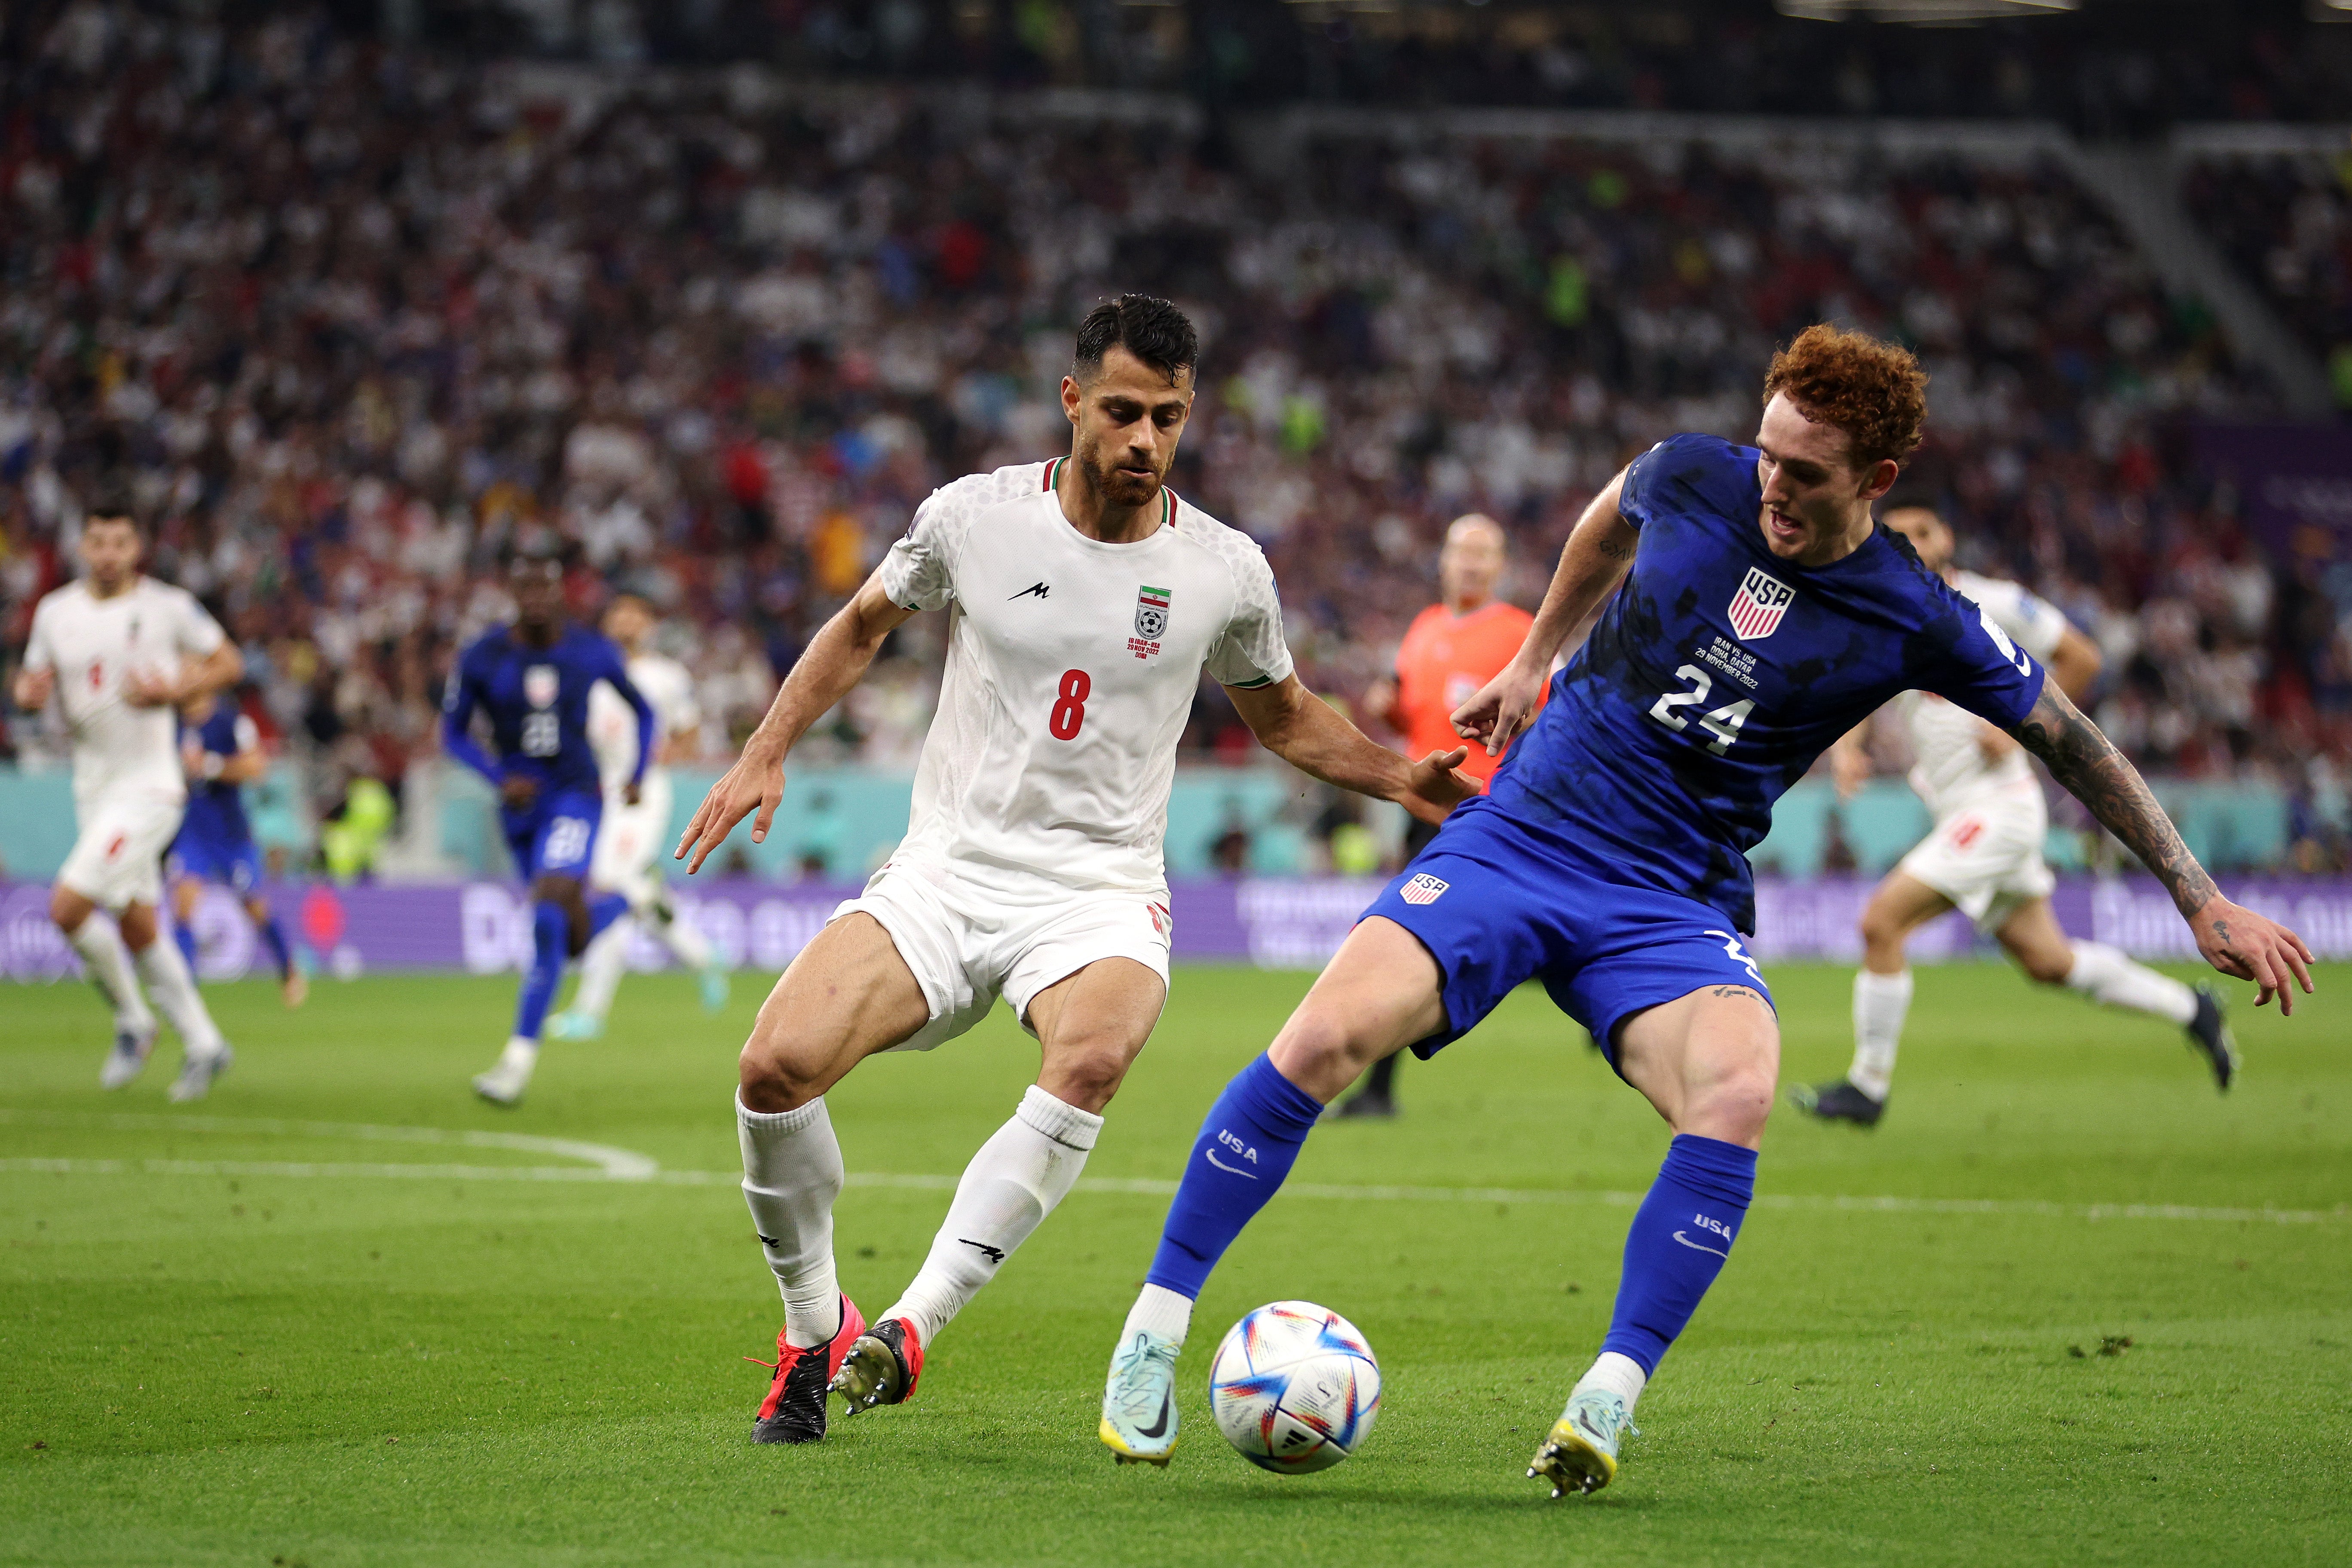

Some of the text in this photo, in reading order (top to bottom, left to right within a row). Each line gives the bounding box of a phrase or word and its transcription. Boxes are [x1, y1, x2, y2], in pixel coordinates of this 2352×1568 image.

[1746, 571, 1792, 606] USA
[1695, 648, 1758, 689] 29 NOVEMBER 2022
[1714, 636, 1757, 666] IRAN VS. USA
[1049, 669, 1091, 740] 8
[1649, 664, 1755, 756] 24
[1415, 875, 1446, 891] USA
[1218, 1129, 1257, 1164] USA
[1694, 1213, 1730, 1241] USA
